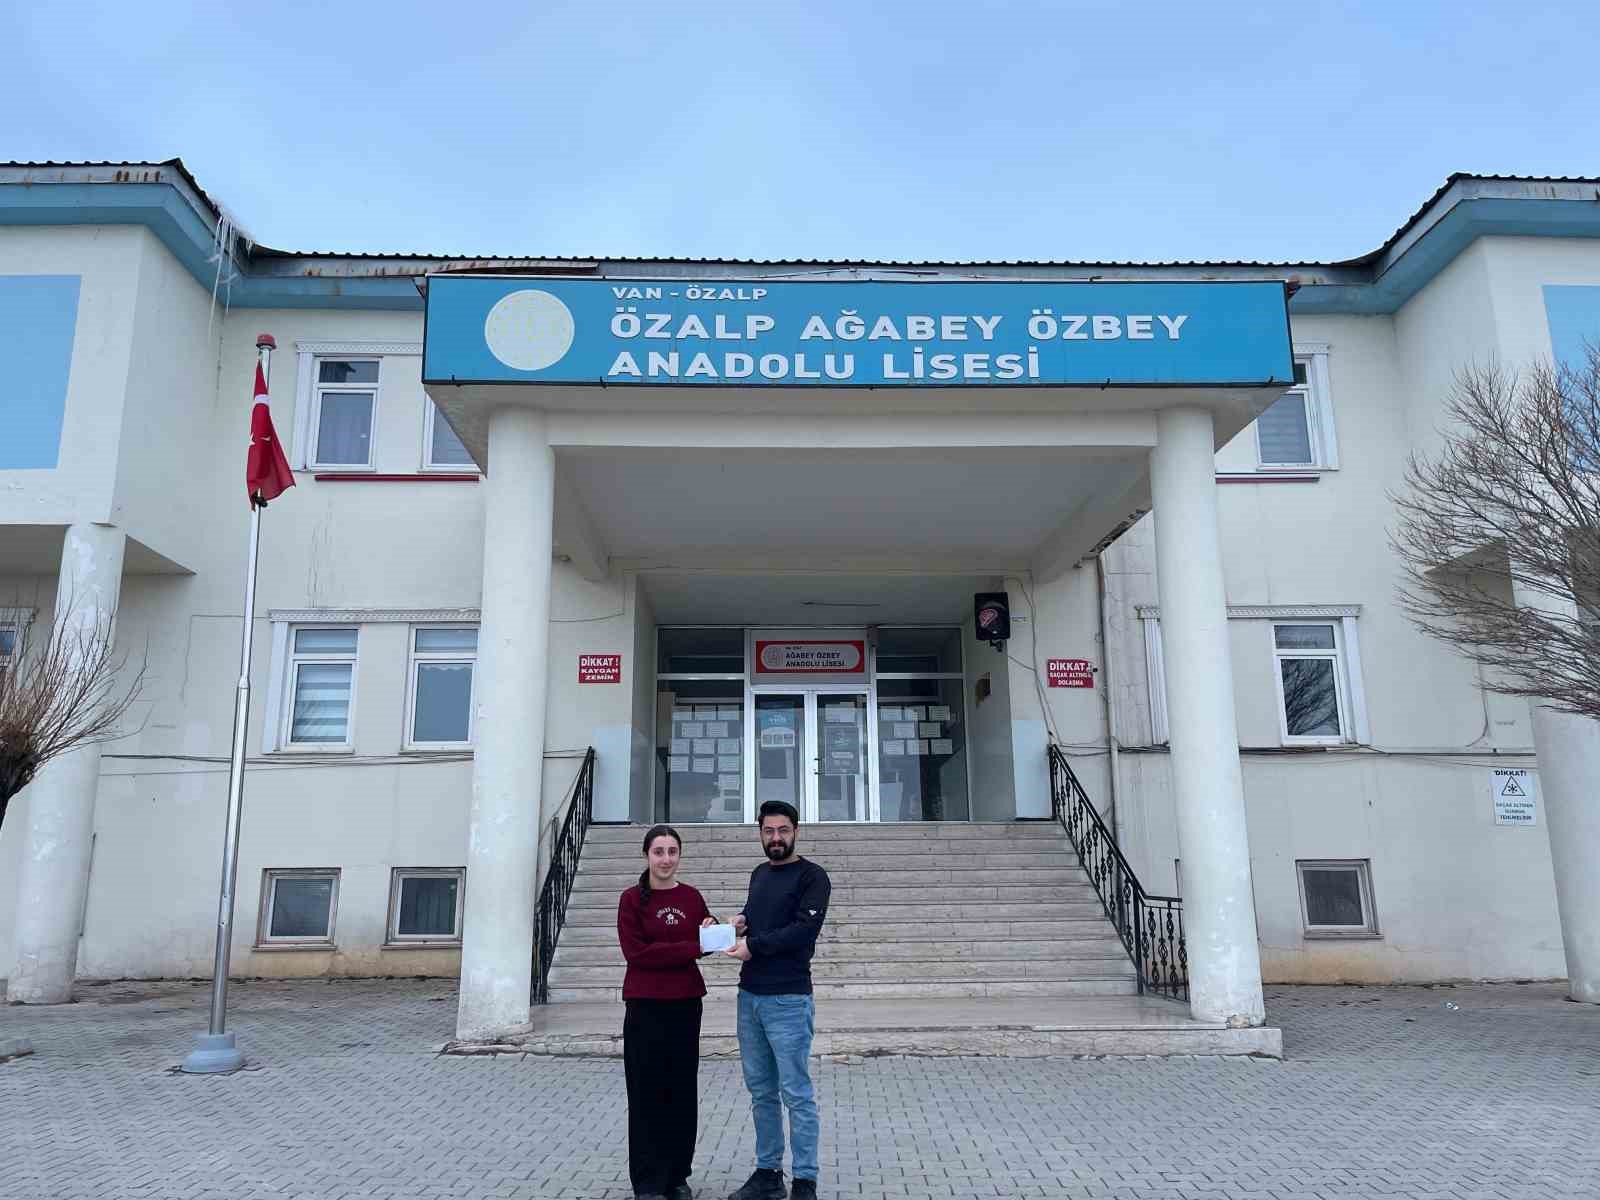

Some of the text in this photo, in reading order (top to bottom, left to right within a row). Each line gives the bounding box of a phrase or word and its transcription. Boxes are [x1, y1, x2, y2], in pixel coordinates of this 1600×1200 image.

[612, 286, 663, 300] VAN
[685, 284, 768, 301] ÖZALP
[610, 306, 1188, 341] ÖZALP AĞABEY ÖZBEY
[607, 345, 1041, 380] ANADOLU LİSESİ
[580, 656, 614, 667] DİKKAT
[1049, 661, 1086, 671] DİKKAT
